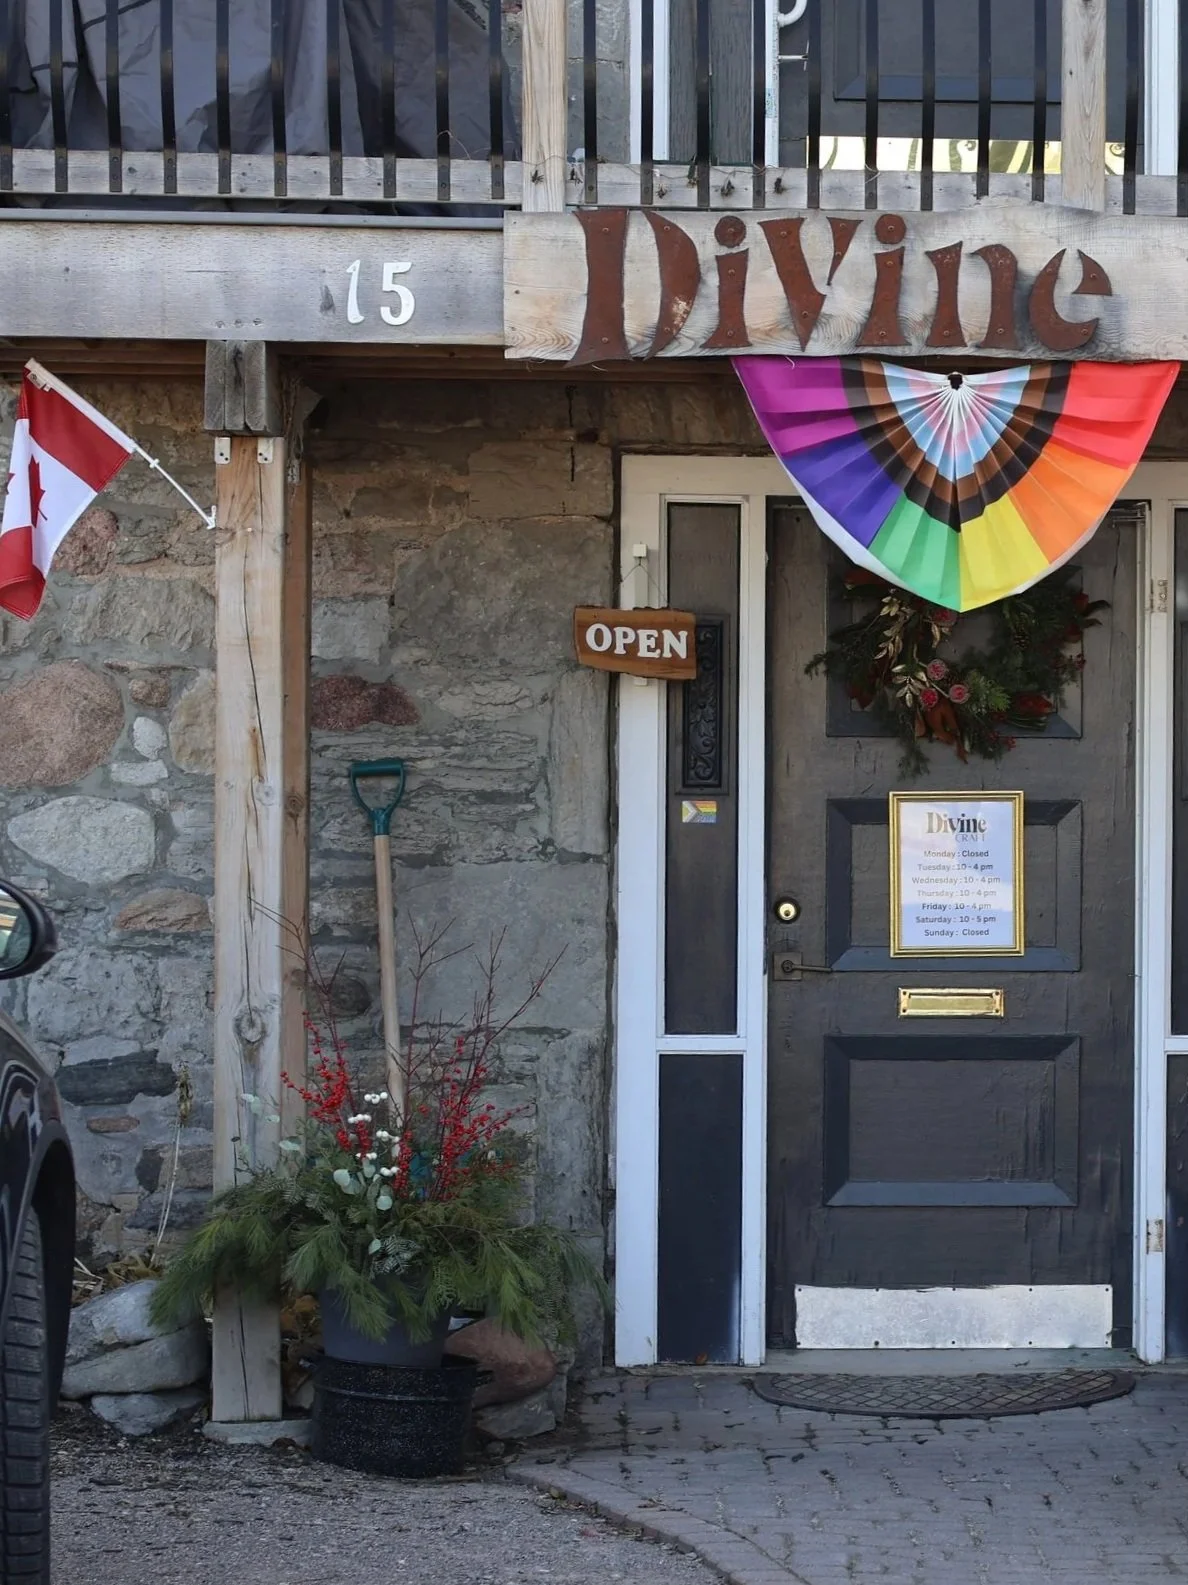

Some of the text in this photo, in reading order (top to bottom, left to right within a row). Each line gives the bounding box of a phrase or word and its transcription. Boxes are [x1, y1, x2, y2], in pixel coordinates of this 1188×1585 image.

[346, 259, 415, 326] 15
[585, 623, 688, 659] OPEN
[924, 812, 987, 834] Divine
[924, 850, 956, 860] Monday
[961, 850, 989, 858] Closed
[917, 863, 951, 872] Tuesday
[957, 863, 967, 871] 10
[980, 864, 994, 872] pm
[911, 877, 958, 886] Wednesday
[964, 876, 974, 884] 10
[917, 890, 954, 898] Thursday
[984, 890, 997, 898] pm
[922, 903, 947, 912] Friday
[915, 916, 952, 925] Saturday
[983, 916, 997, 925] pm
[924, 929, 954, 938] Sunday
